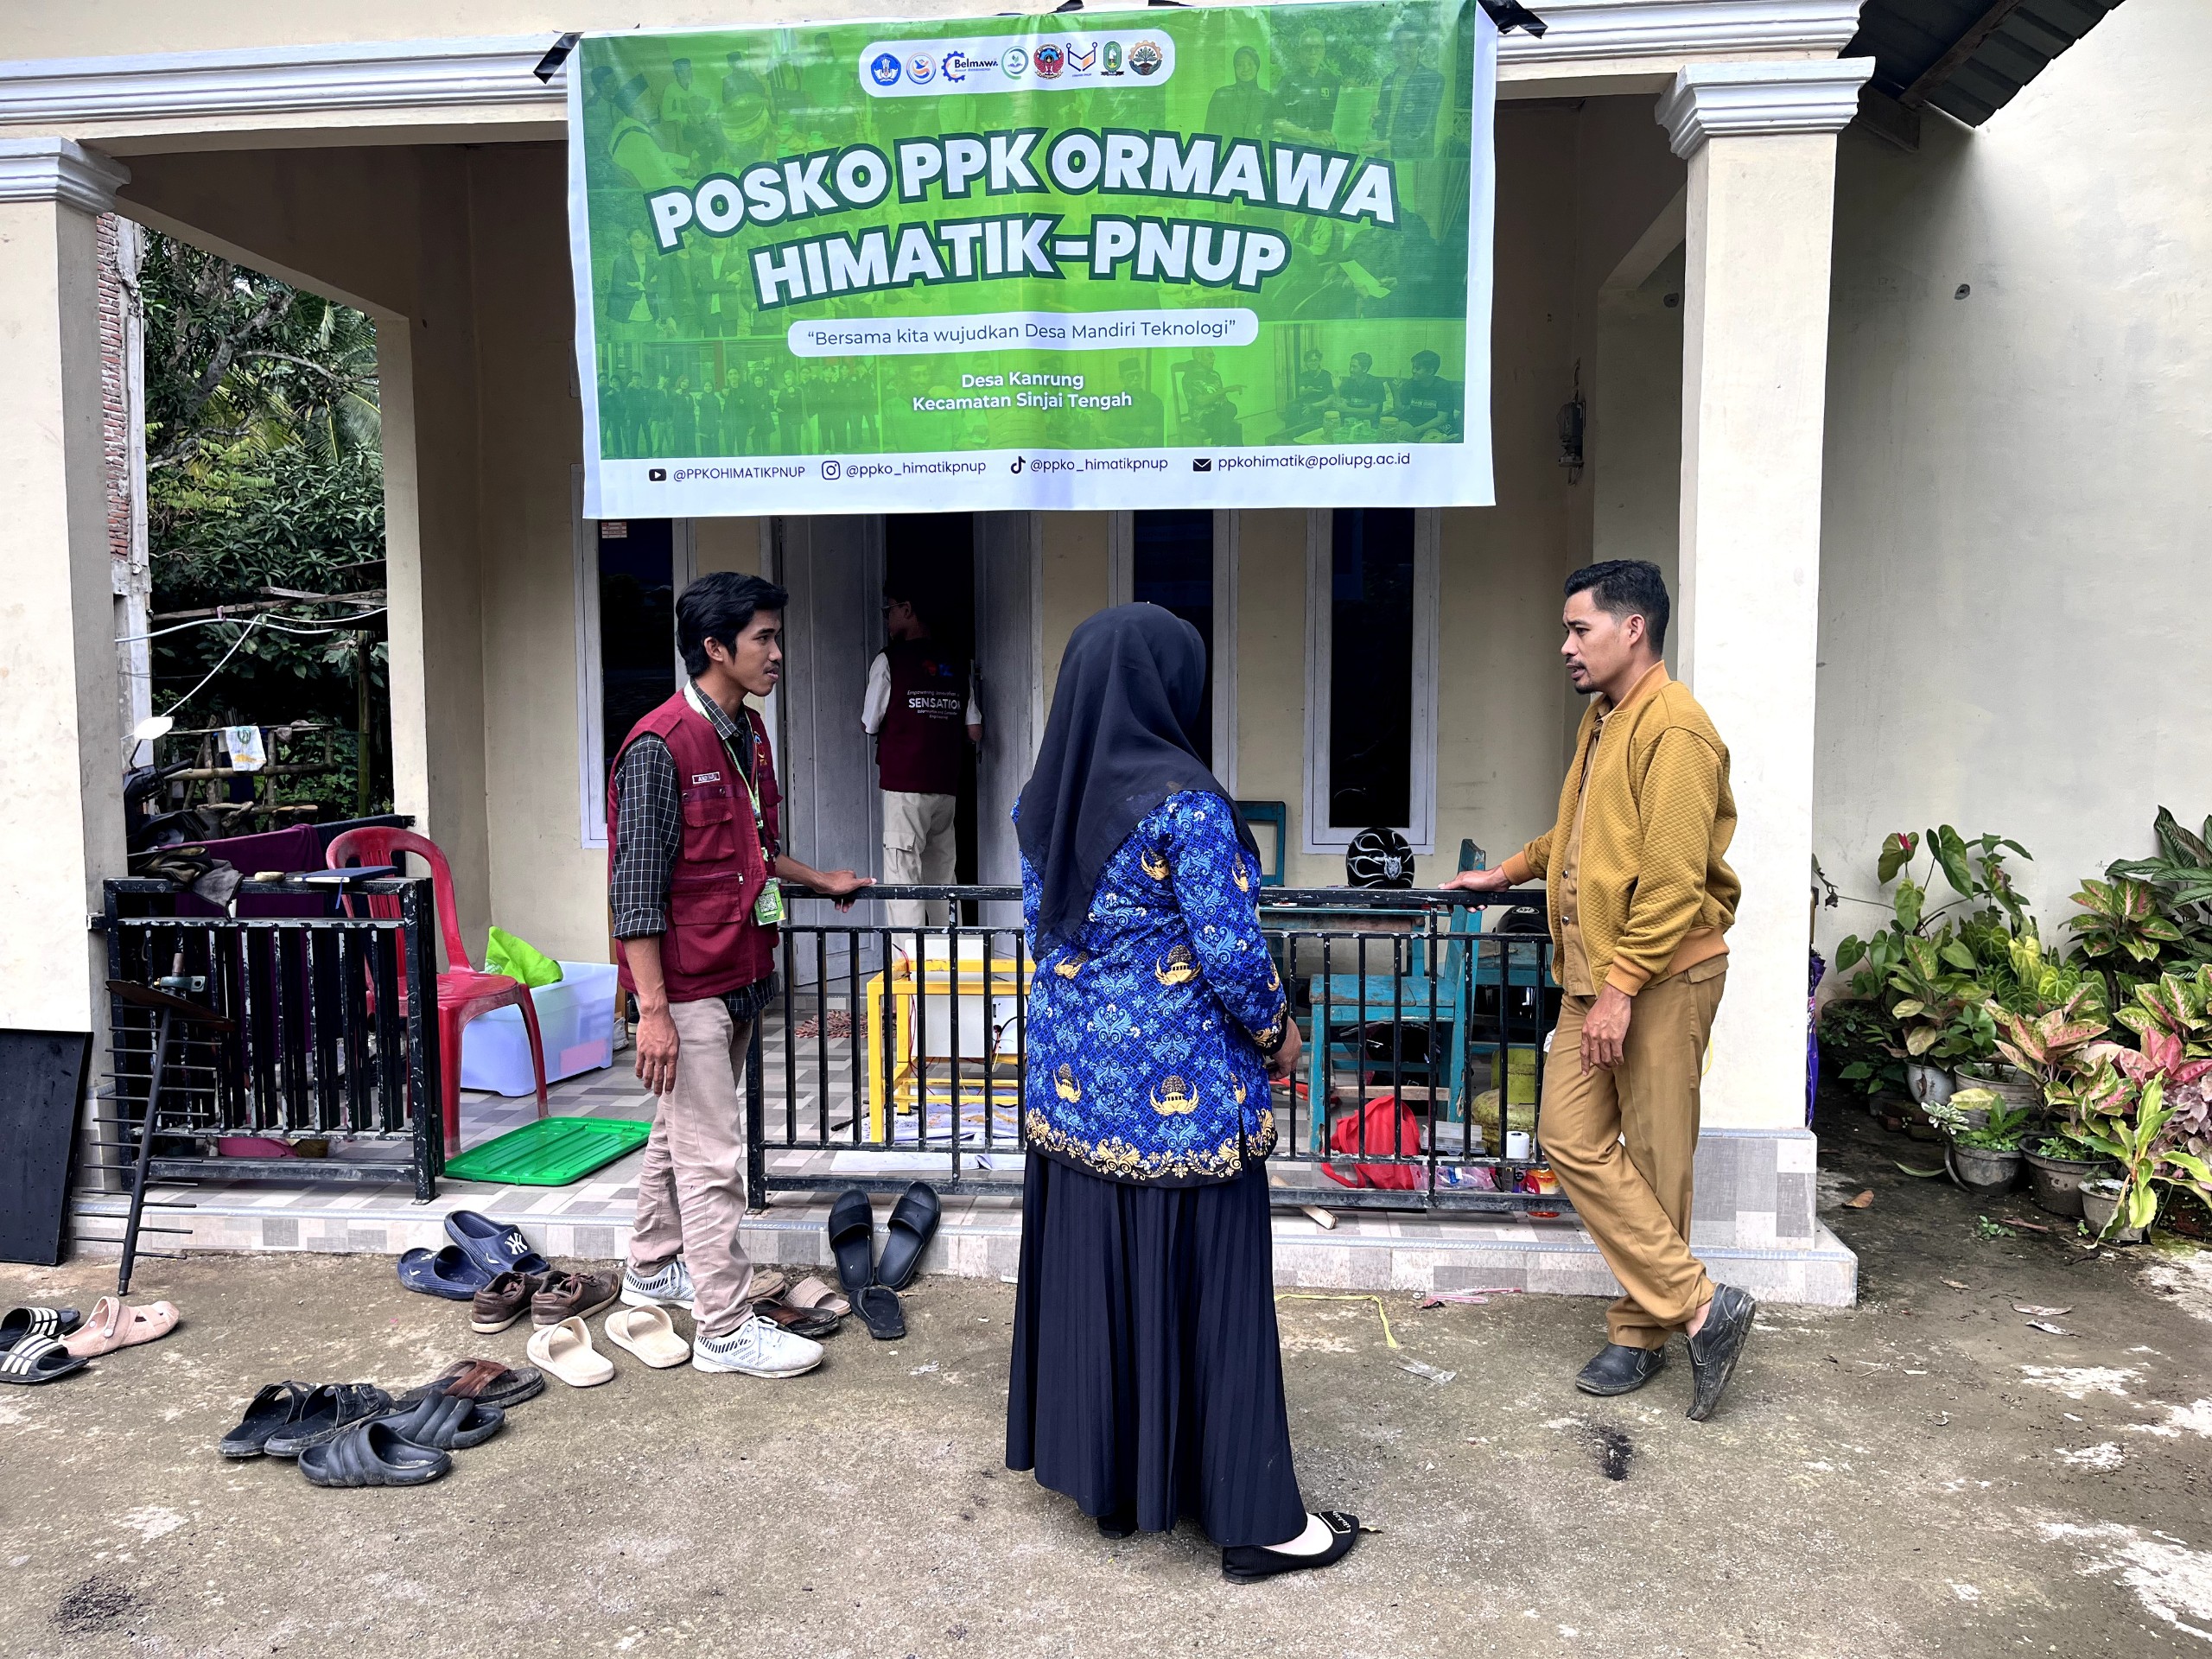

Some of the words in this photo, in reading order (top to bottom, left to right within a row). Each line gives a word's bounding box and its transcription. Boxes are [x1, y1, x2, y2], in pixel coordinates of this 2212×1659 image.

[650, 149, 887, 248] POSKO
[899, 133, 1039, 198] PPK
[1052, 133, 1395, 224] ORMAWA
[753, 219, 1286, 305] HIMATIK-PNUP
[897, 327, 929, 344] kita
[934, 324, 1019, 345] wujudkan
[1025, 323, 1066, 340] Desa
[1071, 321, 1135, 339] Mandiri
[961, 372, 1004, 389] Desa
[1008, 371, 1085, 389] Kanrung
[912, 394, 1011, 411] Kecamatan
[1016, 391, 1064, 411] Sinjai
[1068, 391, 1133, 410] Tengah
[1218, 453, 1411, 471] ppkohimatik@poliupg.ac.id
[673, 467, 805, 481] @PPKOHIMATIKPNUP
